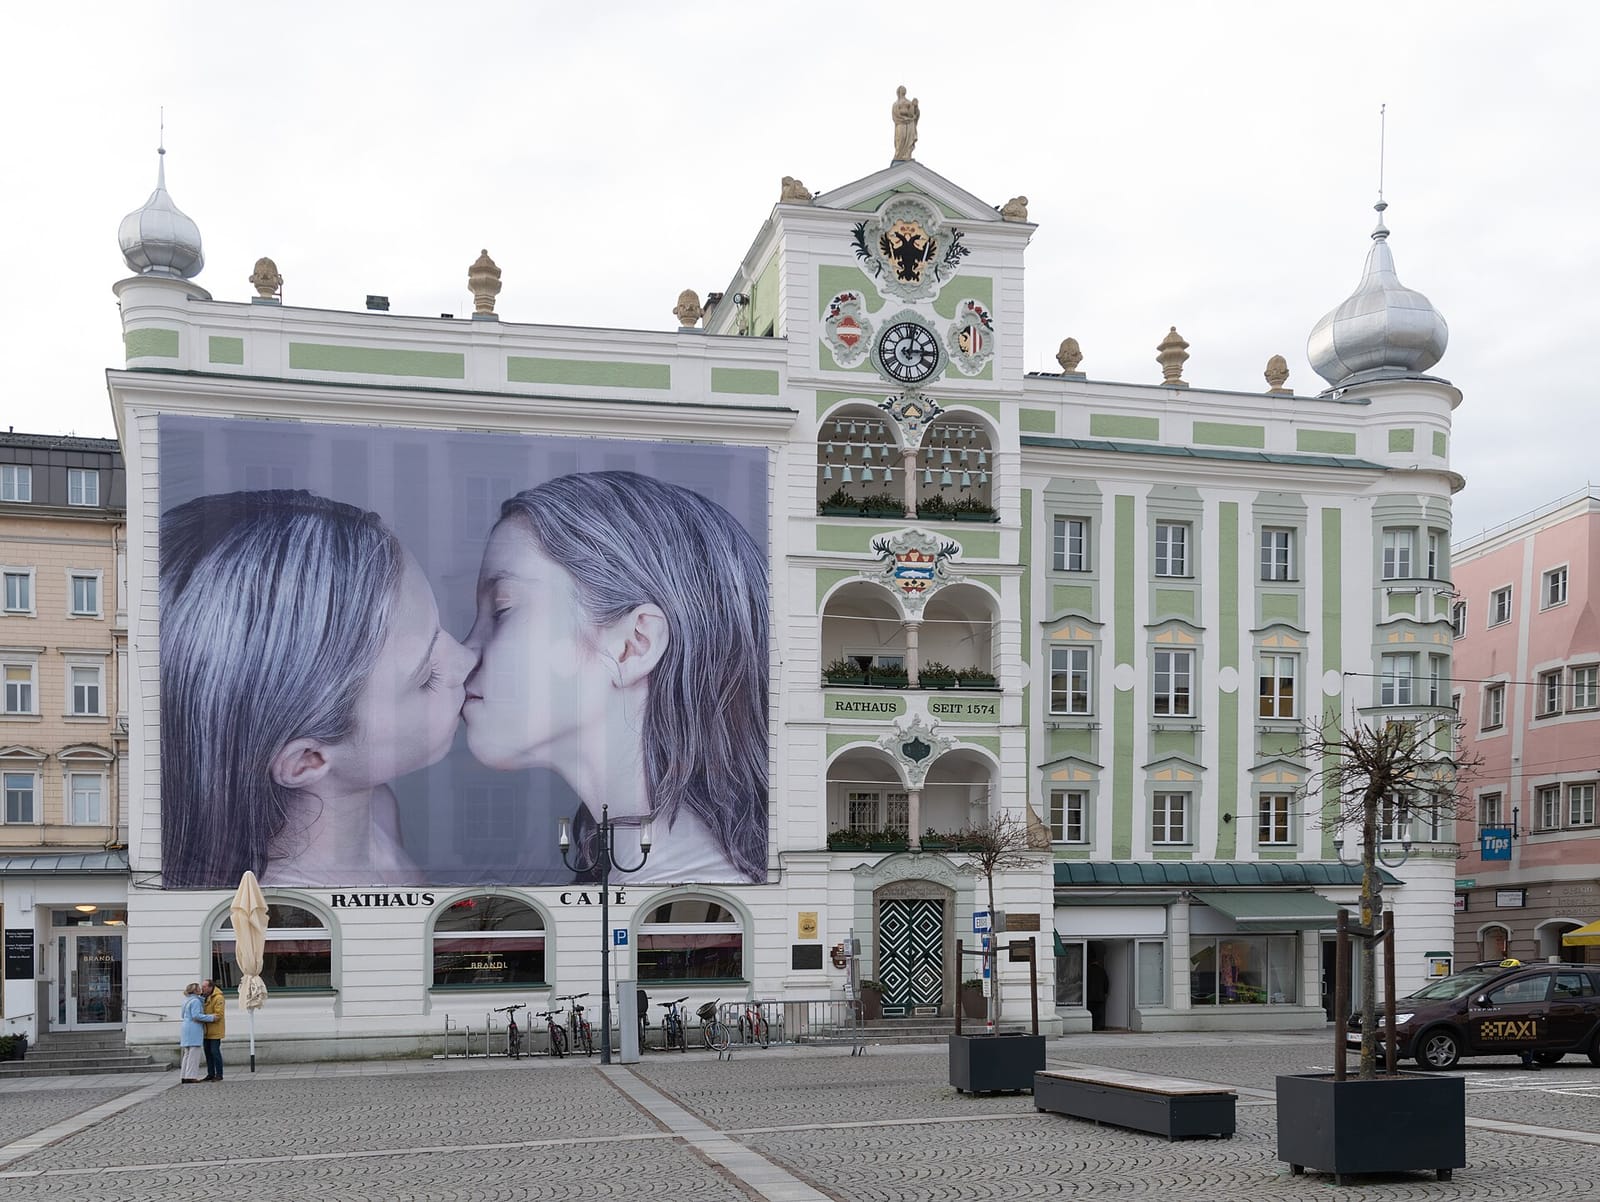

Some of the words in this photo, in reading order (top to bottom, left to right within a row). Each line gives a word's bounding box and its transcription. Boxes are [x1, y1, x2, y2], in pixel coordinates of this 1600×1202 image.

[835, 701, 897, 713] RATHAUS
[932, 703, 963, 714] SEIT
[967, 704, 996, 715] 1574
[1484, 836, 1509, 854] Tips
[331, 892, 435, 908] RATHAUS
[617, 930, 627, 945] P
[471, 961, 509, 970] BRANDL
[1493, 1020, 1537, 1040] TAXI
